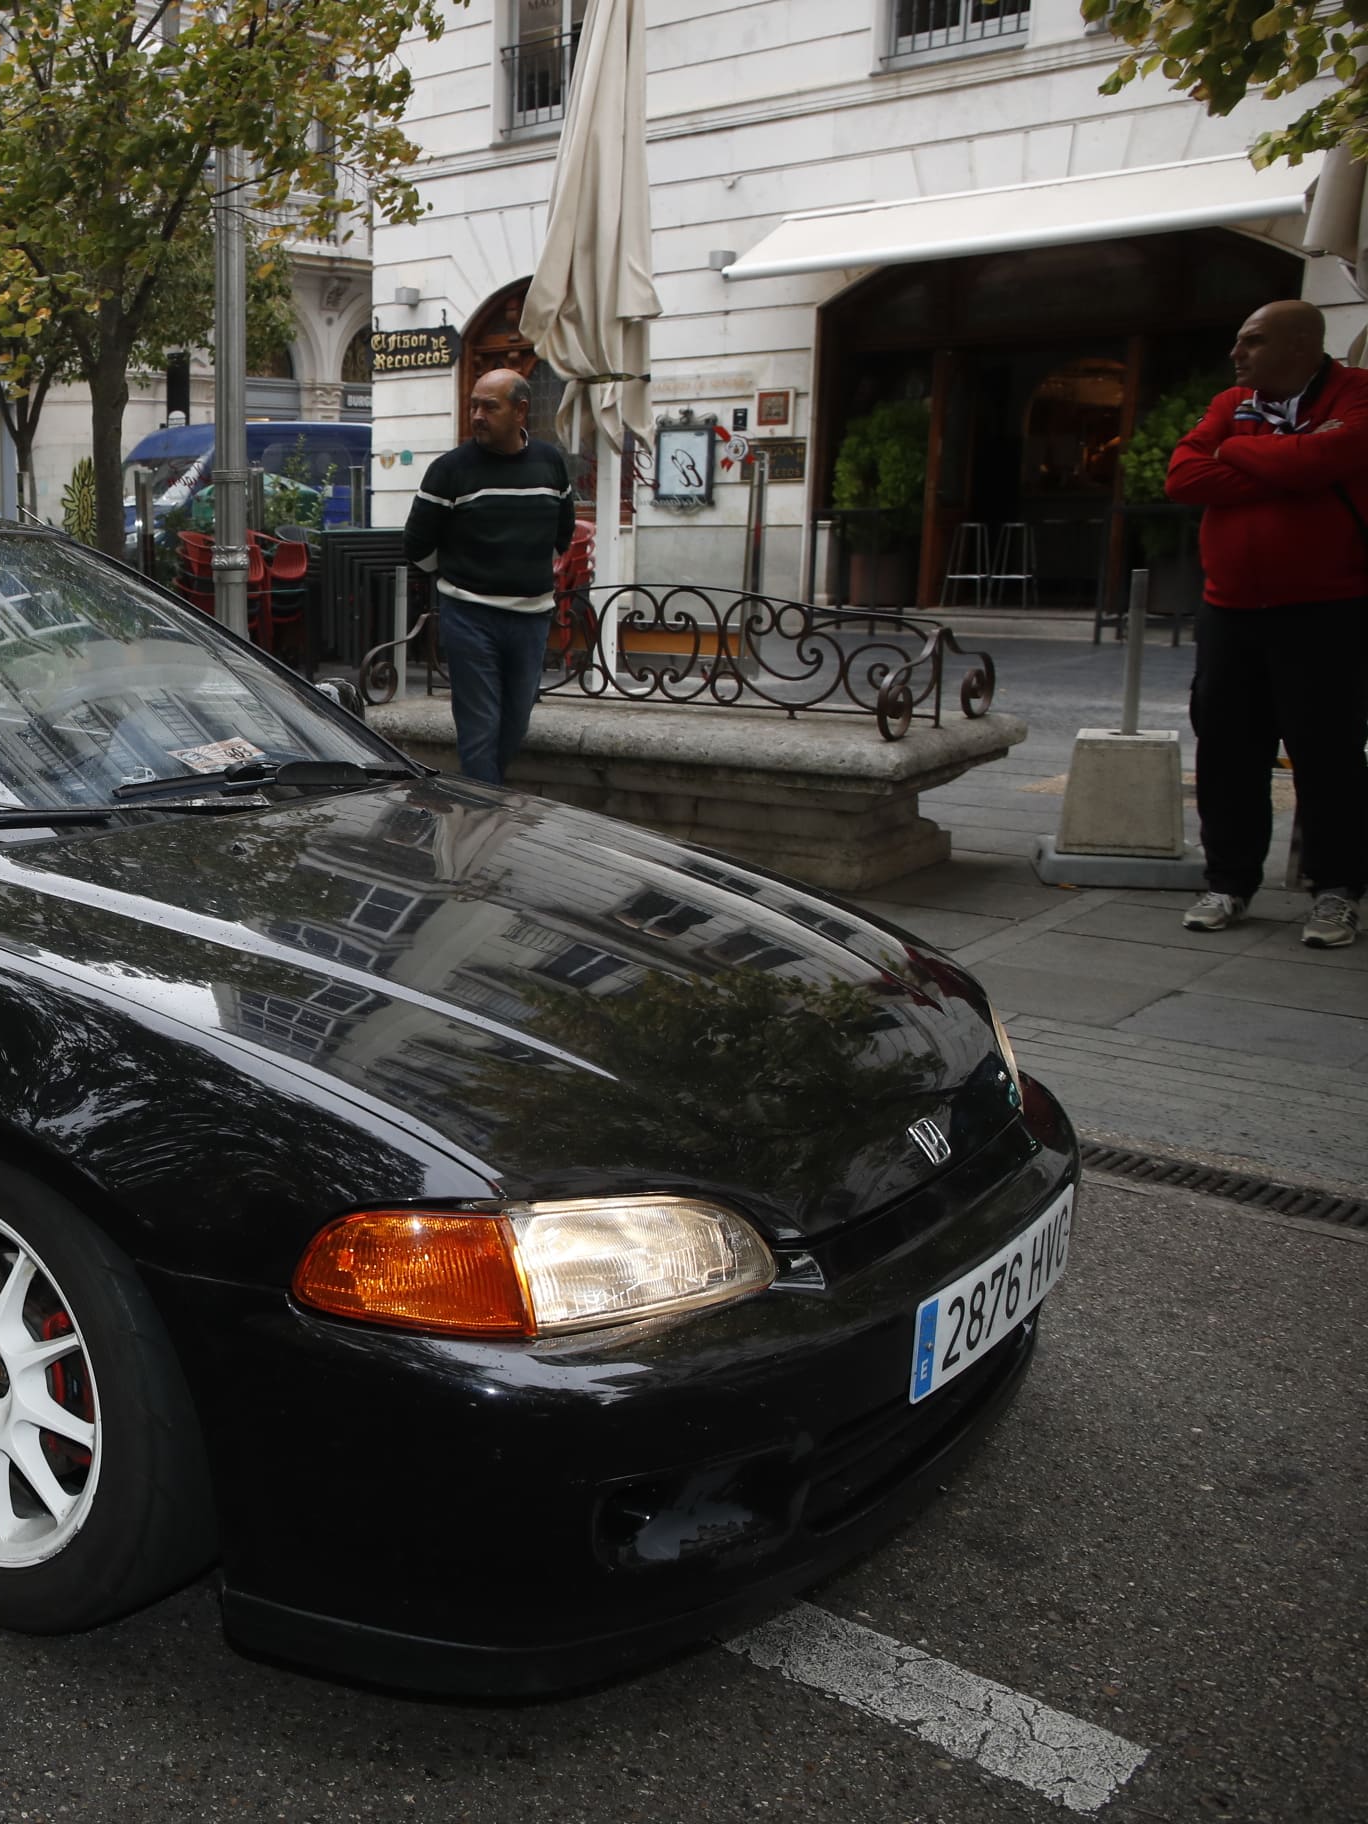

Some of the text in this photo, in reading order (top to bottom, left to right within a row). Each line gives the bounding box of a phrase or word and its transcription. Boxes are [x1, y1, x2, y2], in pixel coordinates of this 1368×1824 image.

[430, 335, 448, 350] de
[373, 348, 452, 371] Recoletos
[941, 1252, 1023, 1372] 2876
[919, 1357, 929, 1380] E
